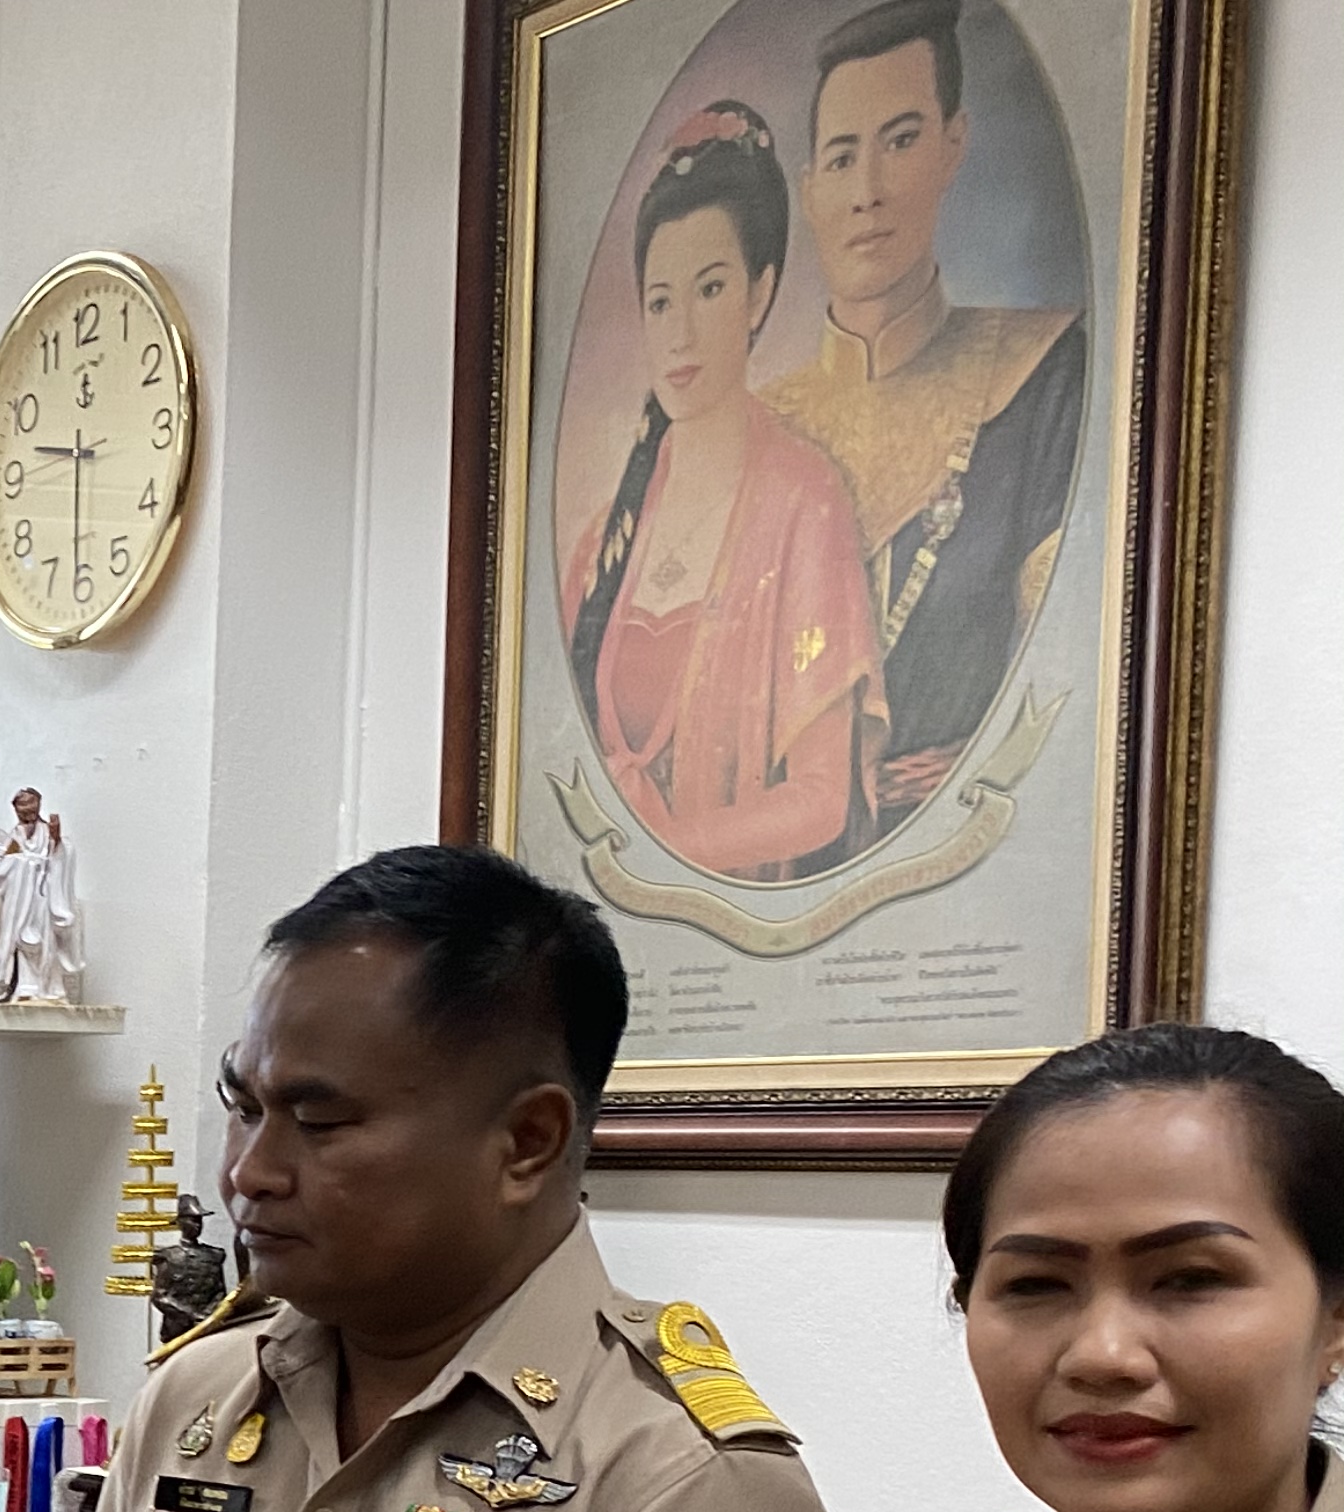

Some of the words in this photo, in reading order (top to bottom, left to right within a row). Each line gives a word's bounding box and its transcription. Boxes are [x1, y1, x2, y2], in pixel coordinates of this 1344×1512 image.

[73, 302, 100, 348] 12
[119, 301, 131, 342] 1
[39, 329, 61, 374] 11
[141, 343, 163, 387] 2
[11, 393, 40, 436] 10
[151, 408, 174, 450] 3
[3, 461, 25, 499] 9
[138, 478, 160, 519] 4
[14, 519, 33, 558] 8
[109, 535, 131, 576] 5
[41, 557, 59, 598] 7
[74, 563, 94, 604] 6
